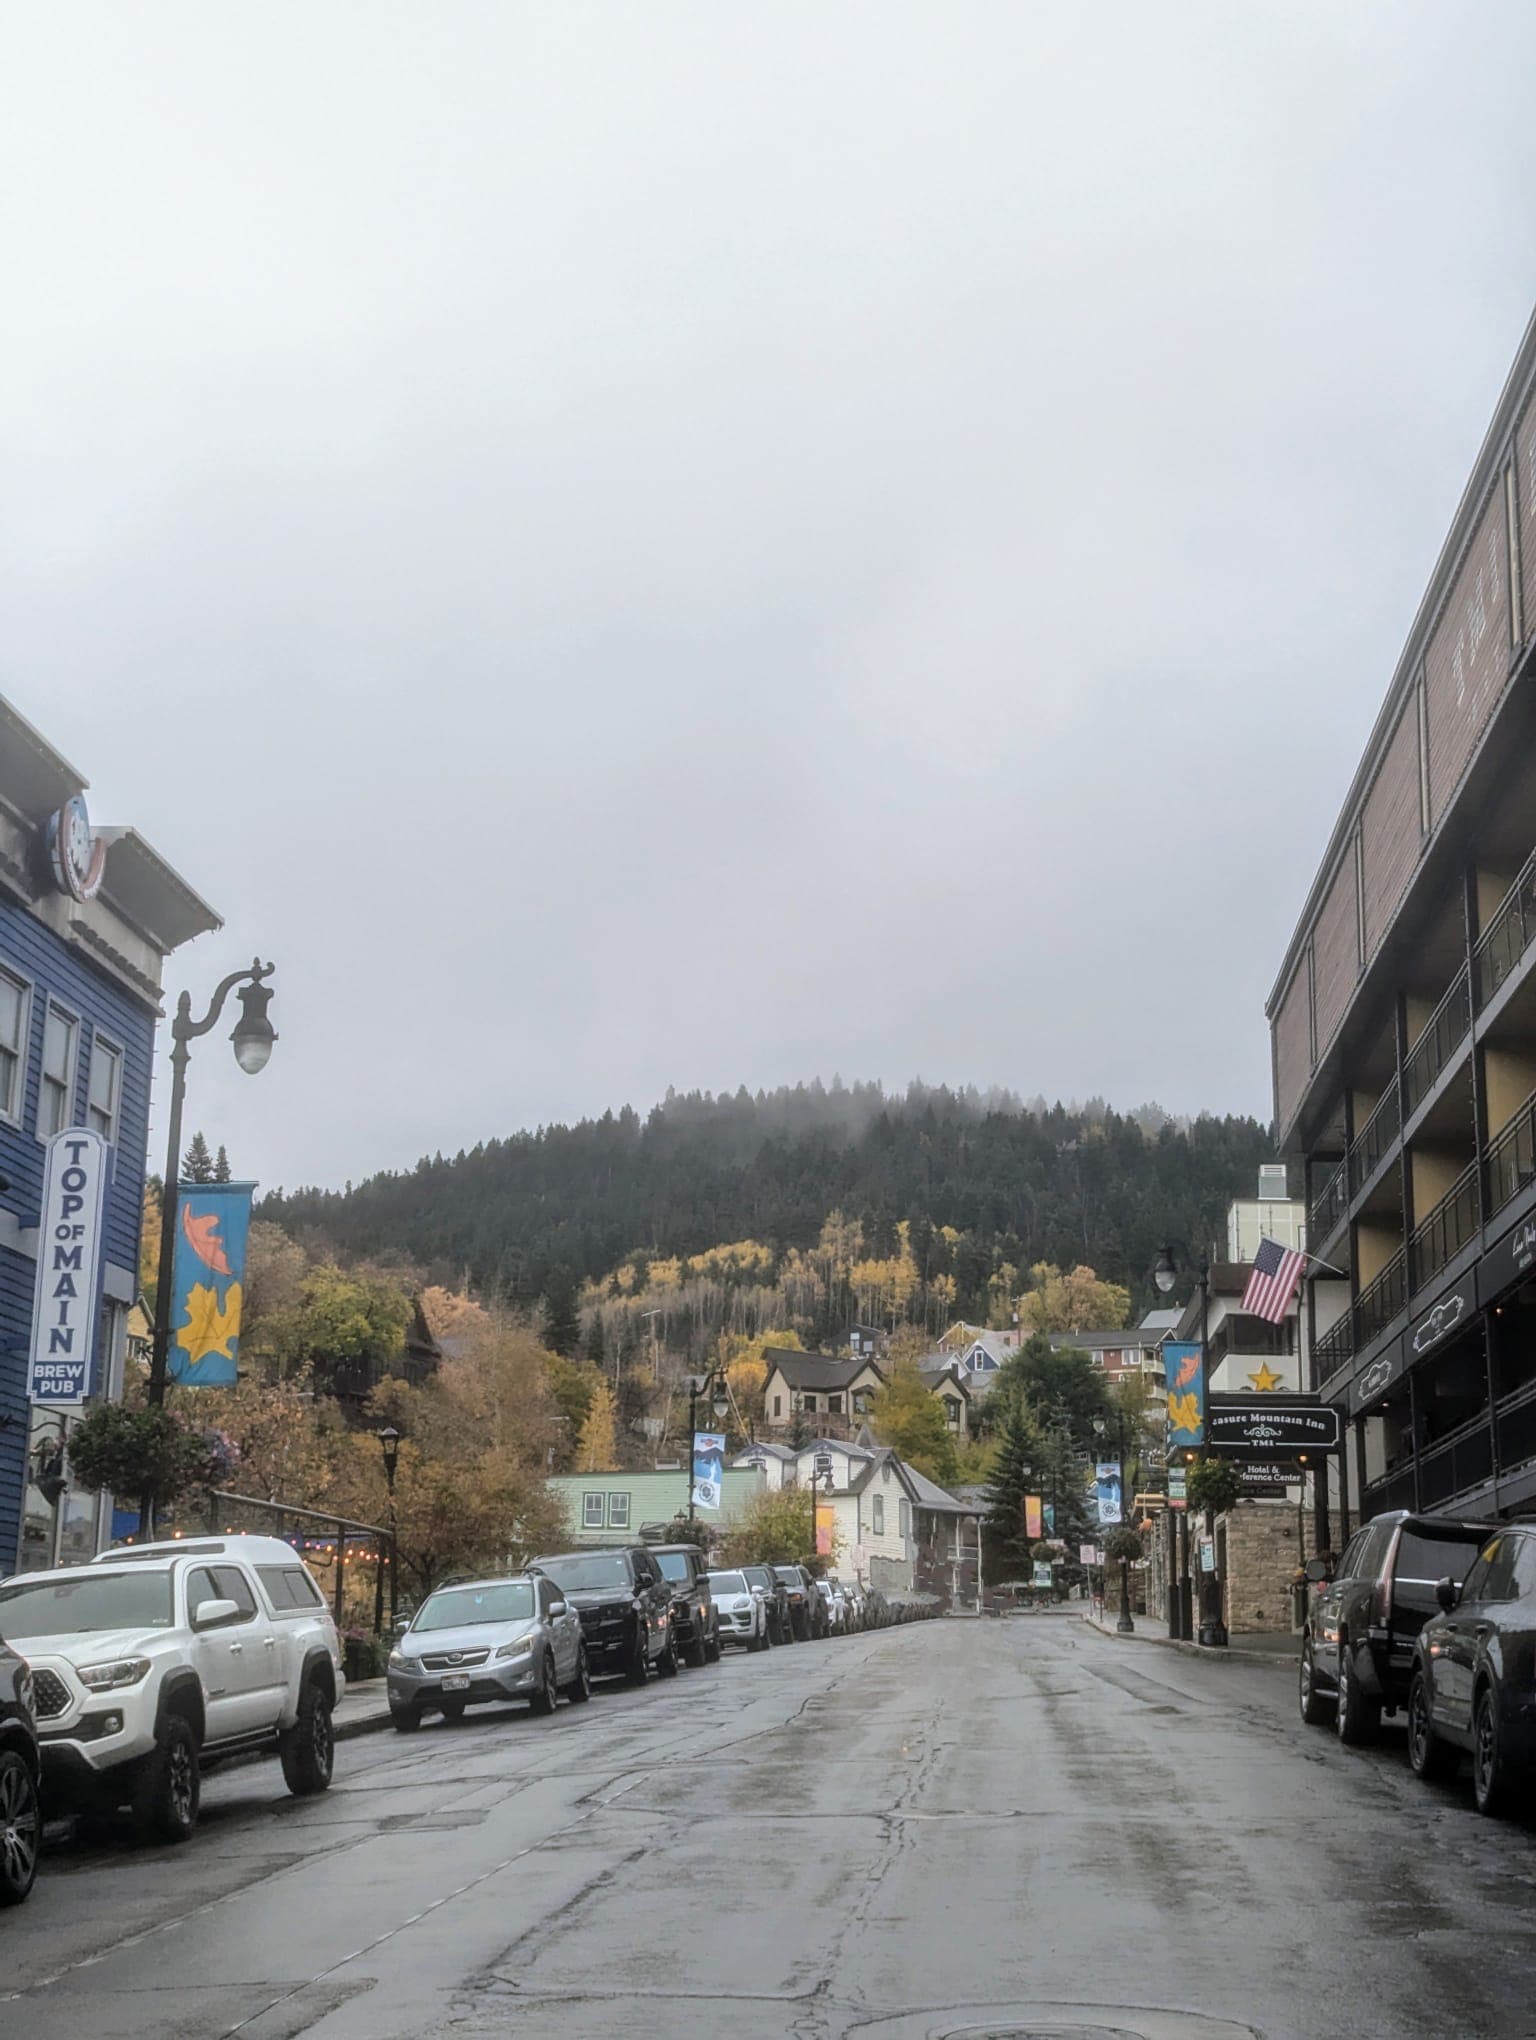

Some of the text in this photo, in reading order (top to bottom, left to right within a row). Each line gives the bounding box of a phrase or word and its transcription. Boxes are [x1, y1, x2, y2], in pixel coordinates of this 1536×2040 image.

[48, 1140, 89, 1354] TOP OF MAIN
[34, 1365, 83, 1378] BREW
[40, 1380, 74, 1394] PUB
[1250, 1413, 1303, 1425] Mountain
[1306, 1417, 1326, 1430] Inn
[1251, 1439, 1274, 1447] TMI
[1247, 1465, 1280, 1473] Hotel &
